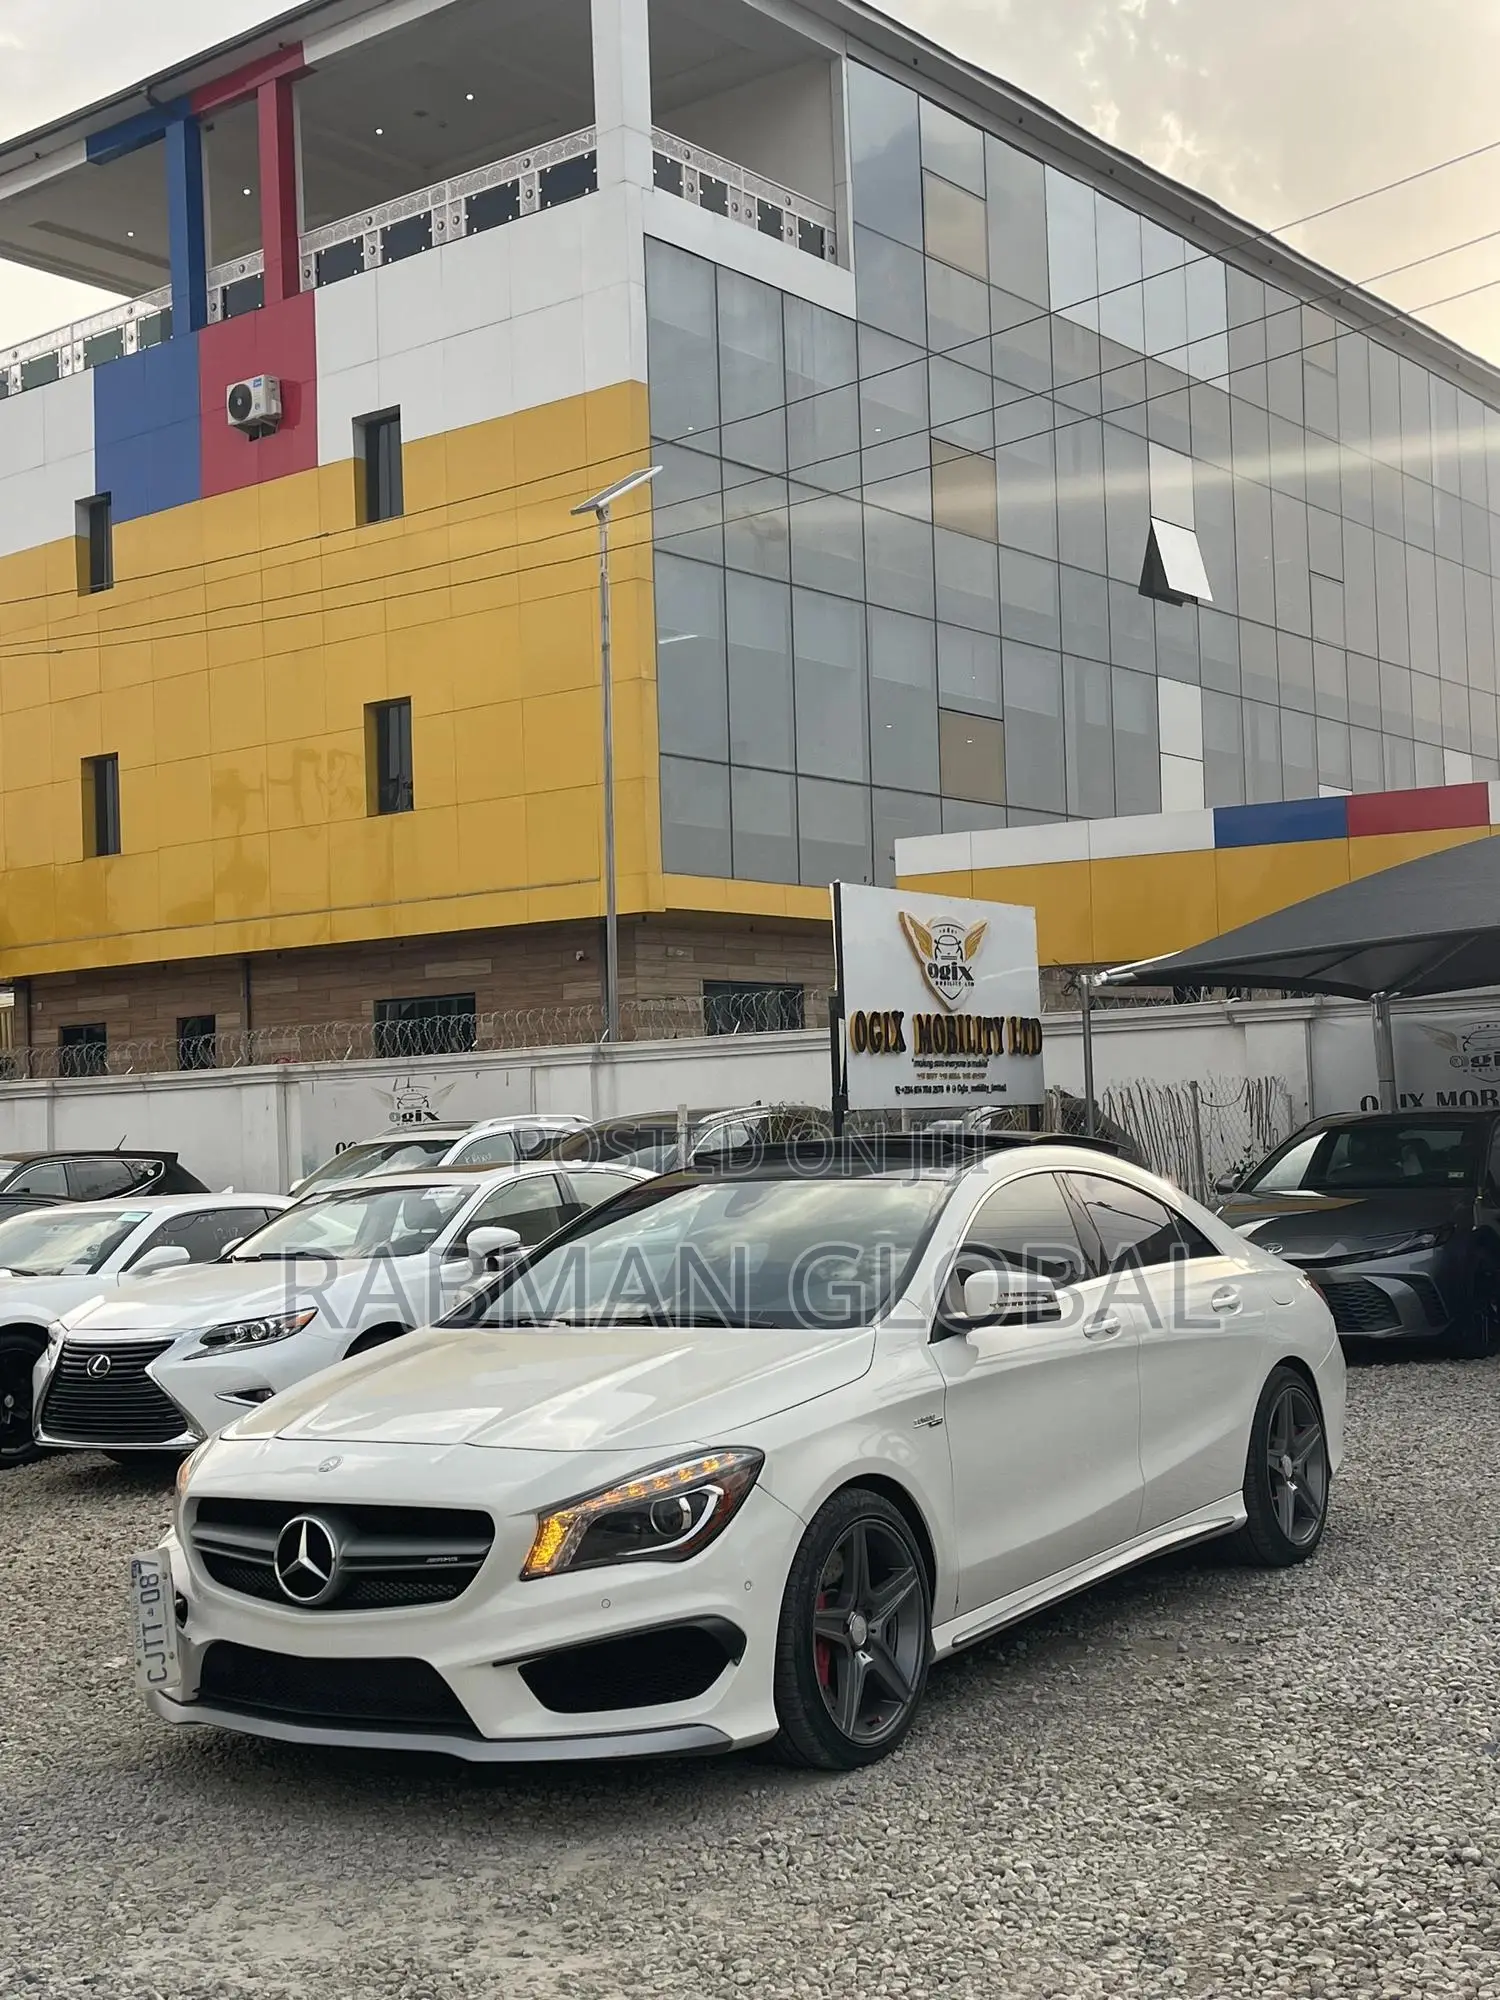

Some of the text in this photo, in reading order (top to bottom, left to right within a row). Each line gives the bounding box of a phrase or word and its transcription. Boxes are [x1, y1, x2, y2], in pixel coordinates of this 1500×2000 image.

[851, 1010, 1042, 1056] OGIX MOBILITY LTD
[1360, 1092, 1424, 1111] OIX
